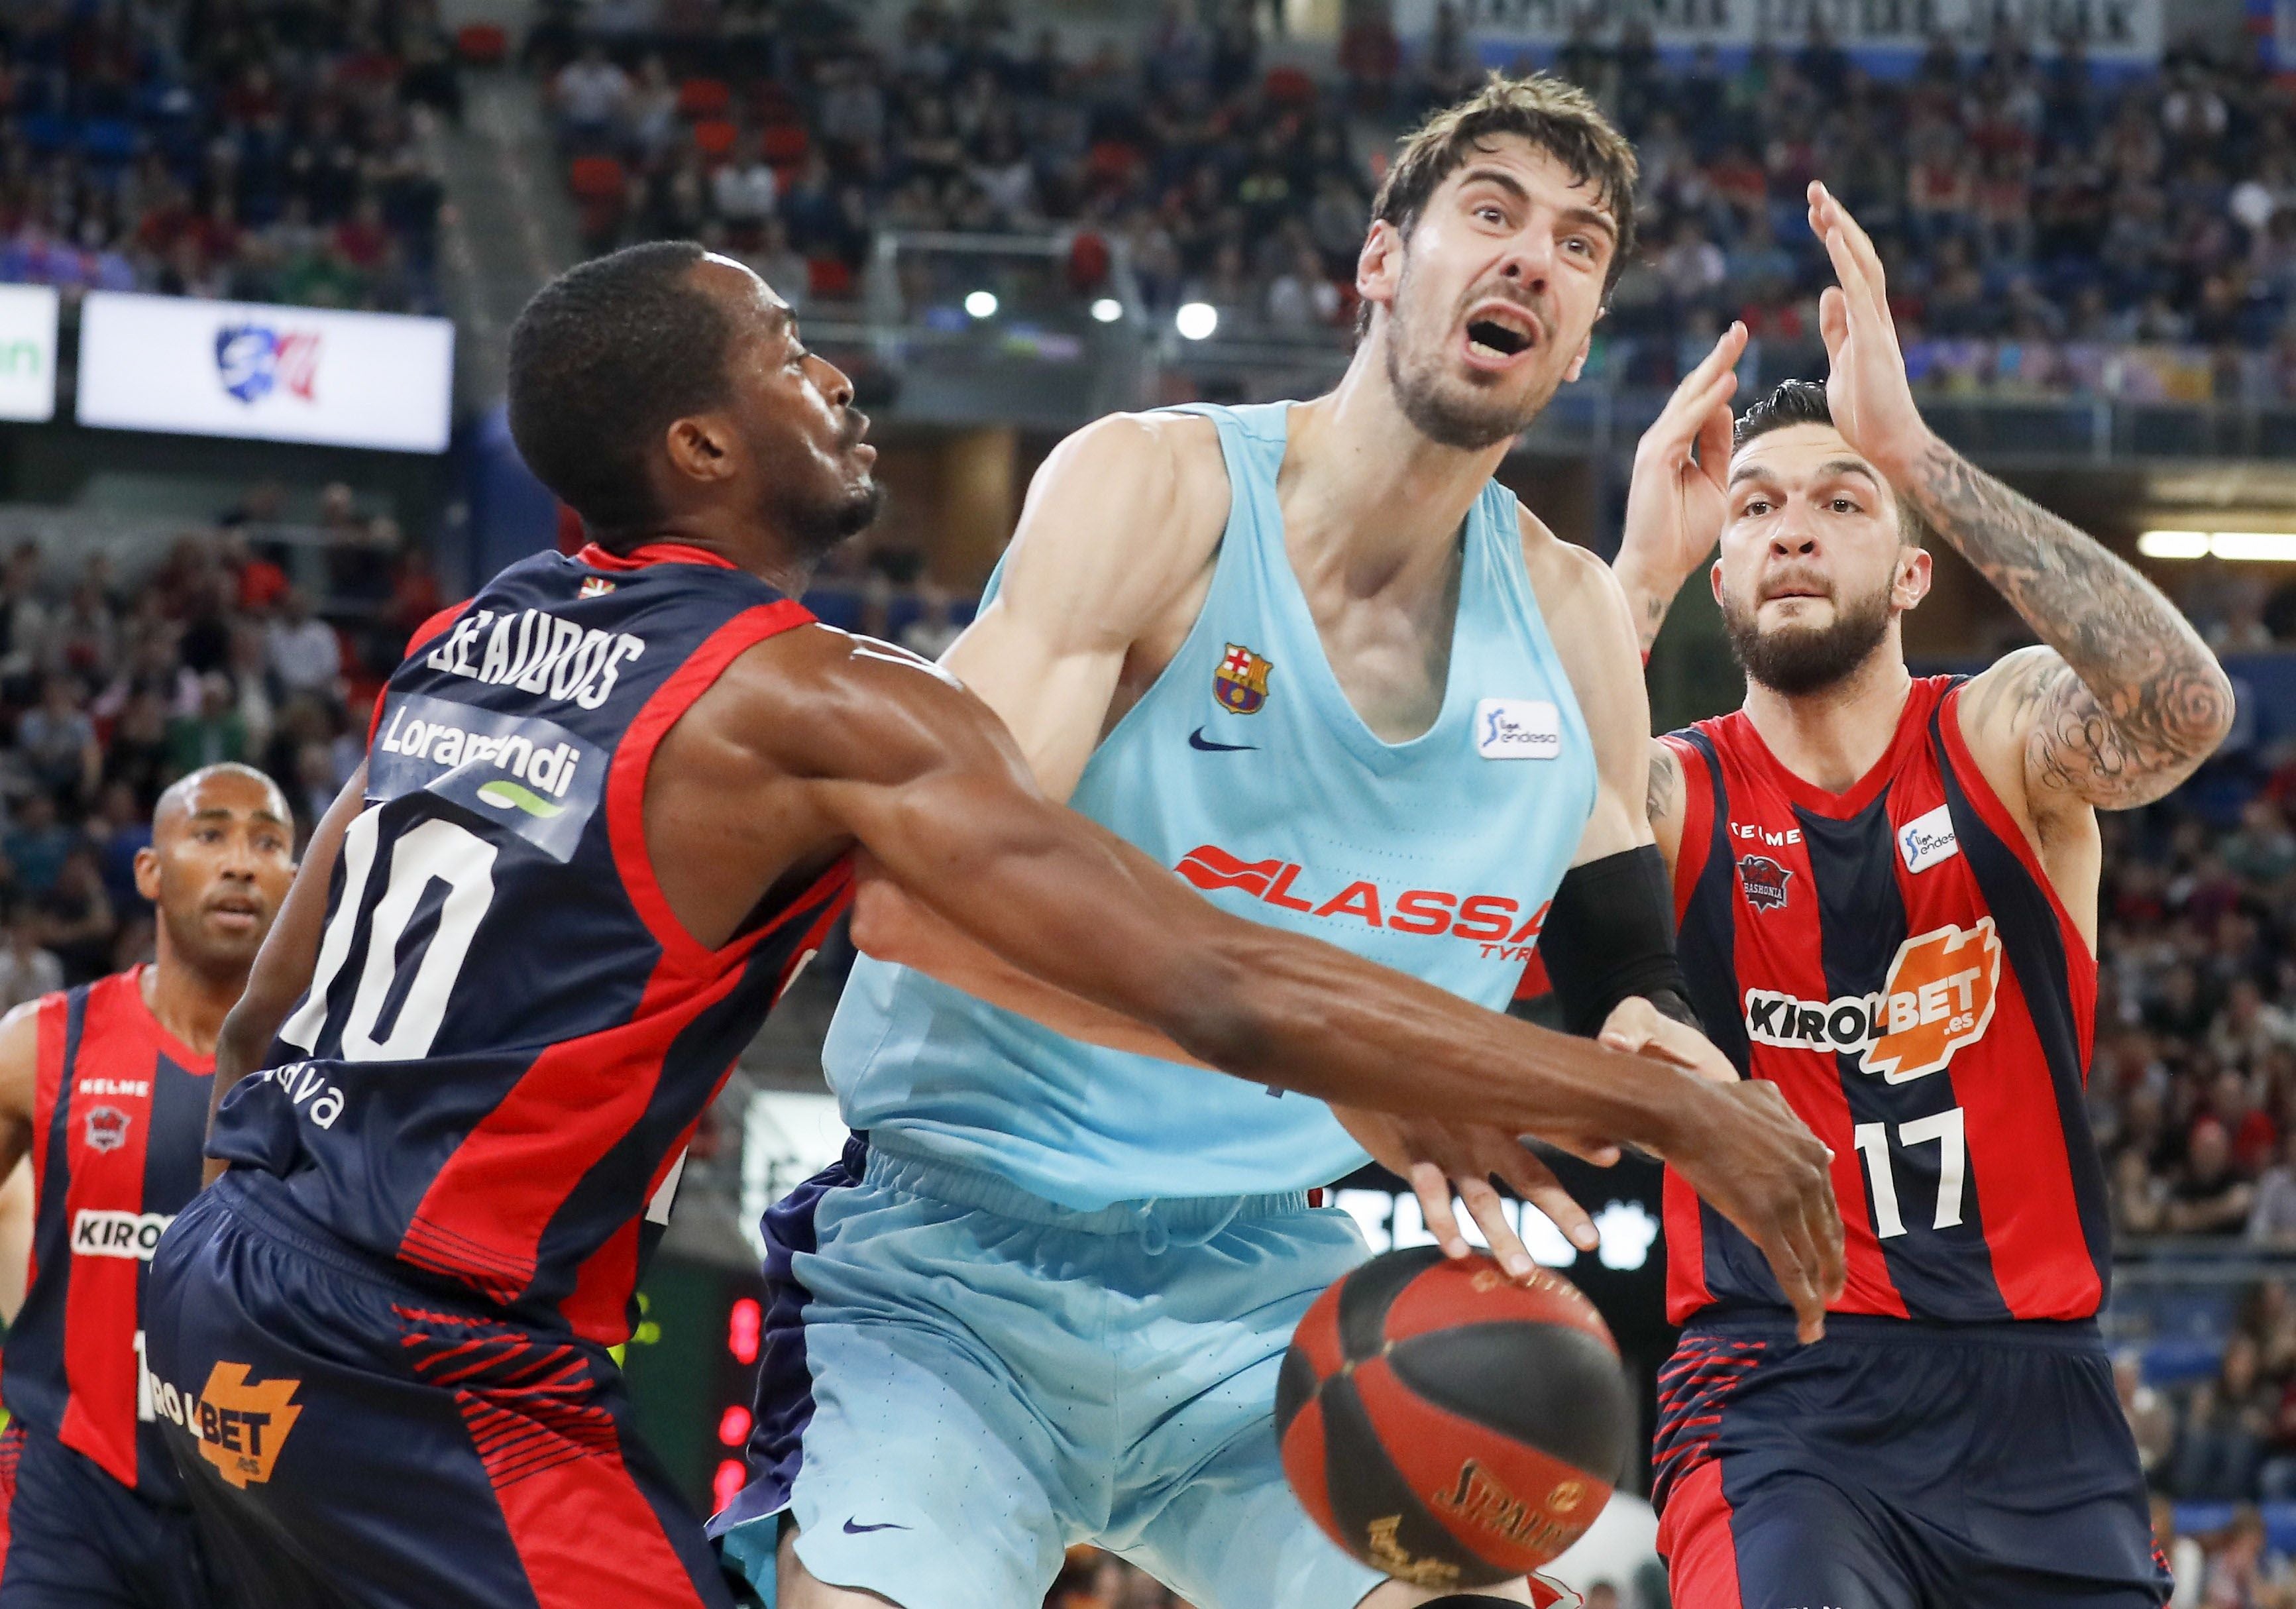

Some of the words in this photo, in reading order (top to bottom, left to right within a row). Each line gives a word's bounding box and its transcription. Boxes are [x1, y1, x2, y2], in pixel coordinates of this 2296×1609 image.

[278, 803, 498, 1062] 10
[1749, 966, 1981, 1045] KIROLBET
[1943, 1011, 1974, 1036] .es
[1854, 1107, 1967, 1239] 17
